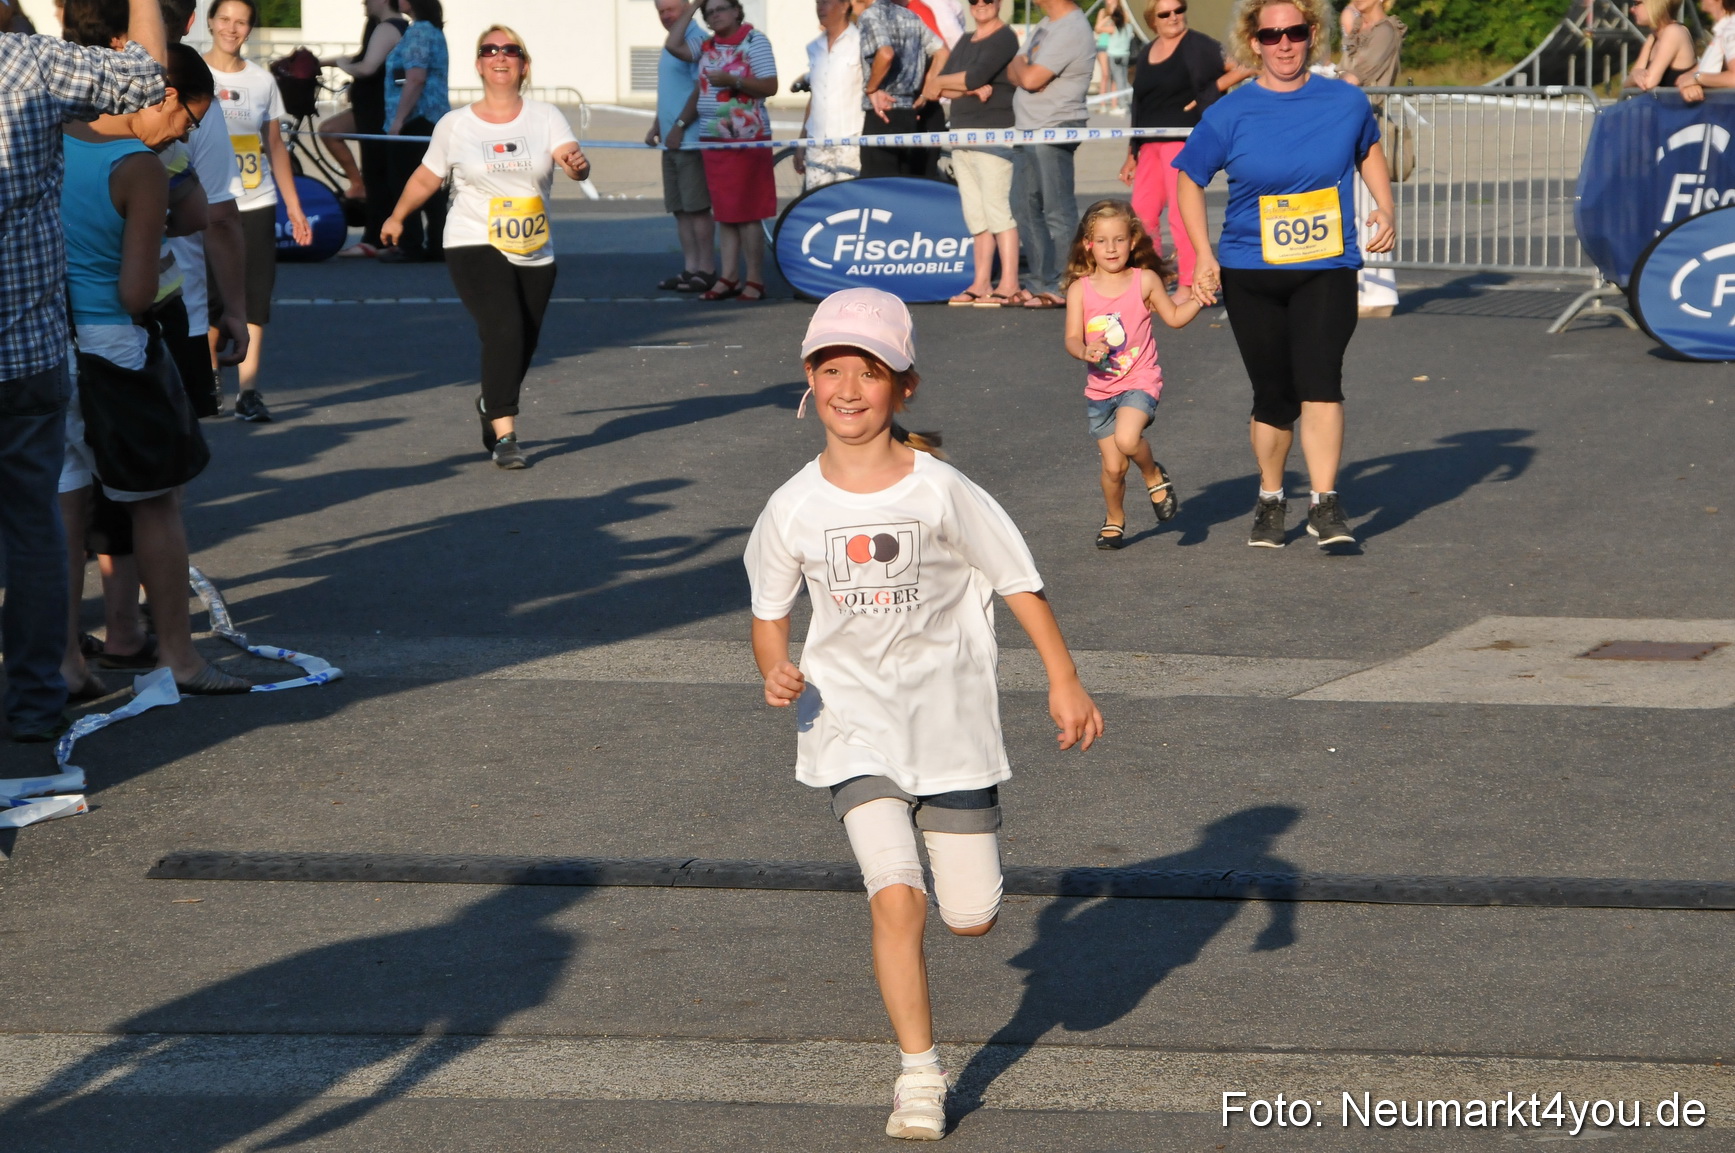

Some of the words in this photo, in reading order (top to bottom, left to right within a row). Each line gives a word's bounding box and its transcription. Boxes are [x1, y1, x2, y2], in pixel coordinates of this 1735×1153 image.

[485, 160, 532, 171] POLGER
[491, 213, 546, 239] 1002
[1273, 214, 1329, 246] 695
[832, 232, 975, 262] Fischer
[846, 261, 965, 276] AUTOMOBILE
[832, 588, 920, 608] POLGER
